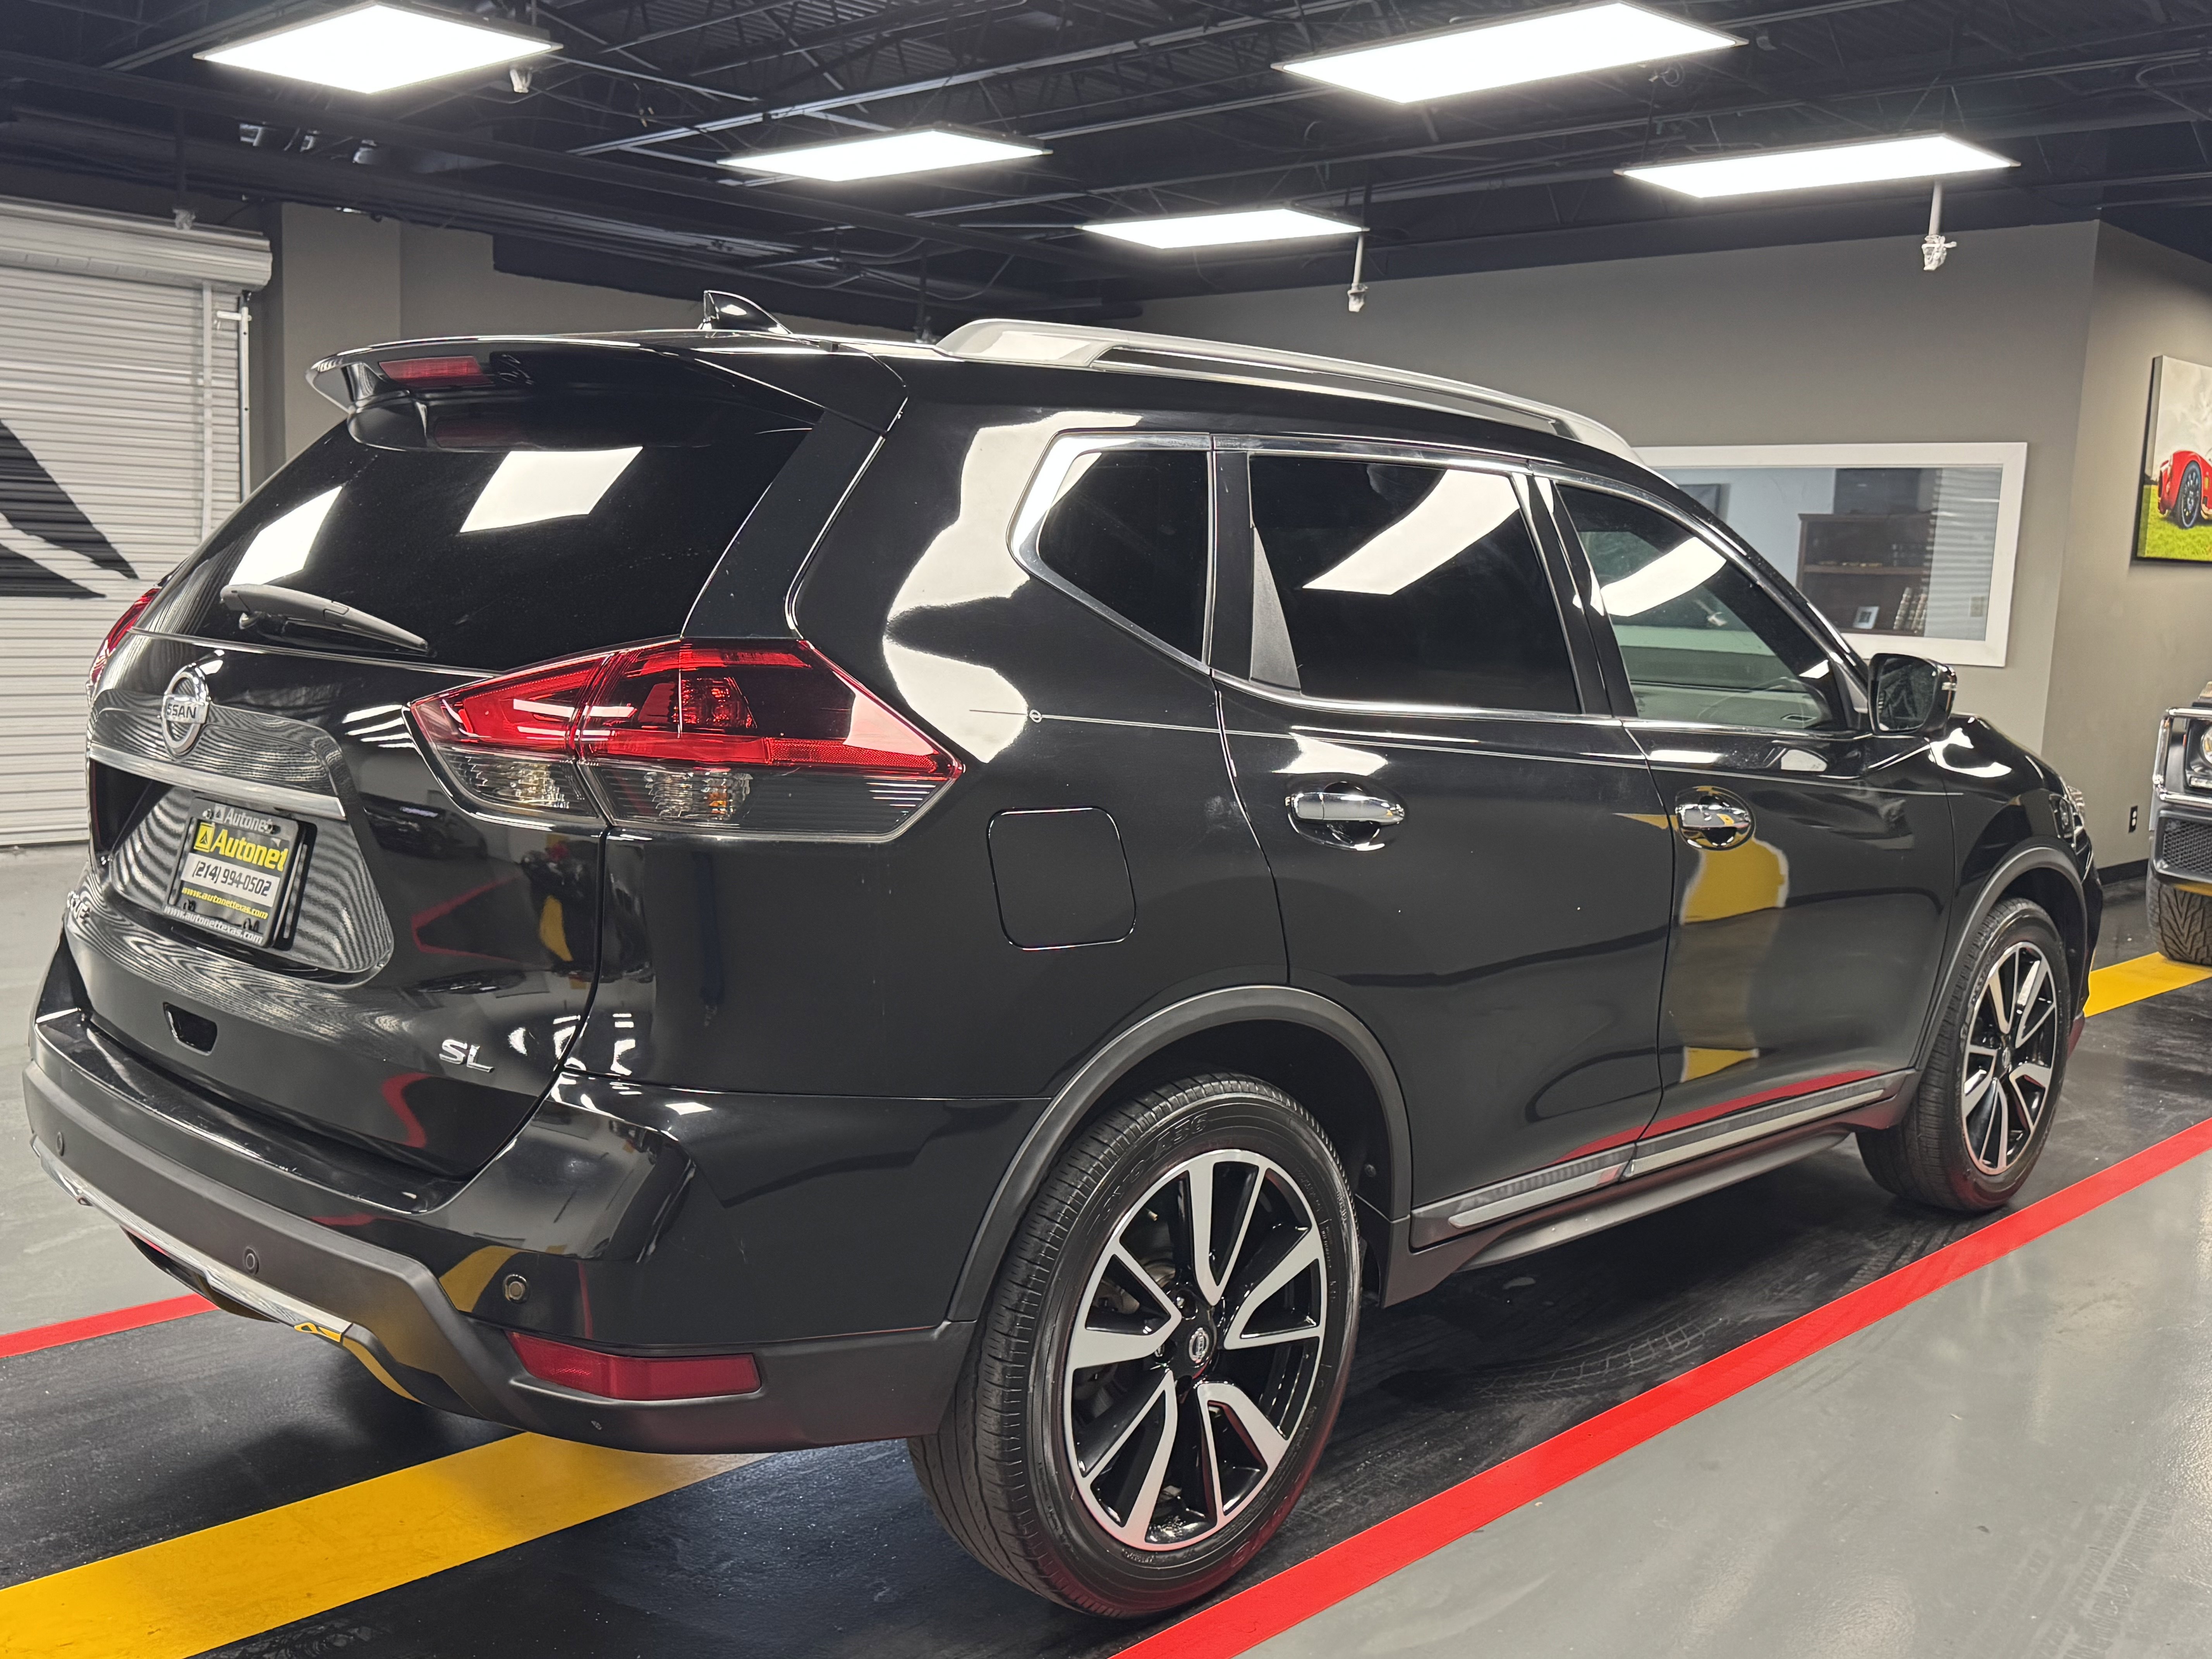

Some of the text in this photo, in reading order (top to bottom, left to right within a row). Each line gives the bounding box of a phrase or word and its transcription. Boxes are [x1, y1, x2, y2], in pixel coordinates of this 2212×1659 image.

[210, 829, 289, 872] Autonet
[192, 860, 272, 897] (214) 994-0502
[181, 887, 269, 920] www.autonettexas.com
[164, 905, 264, 945] www.autonettexas.com
[439, 1039, 496, 1073] SL
